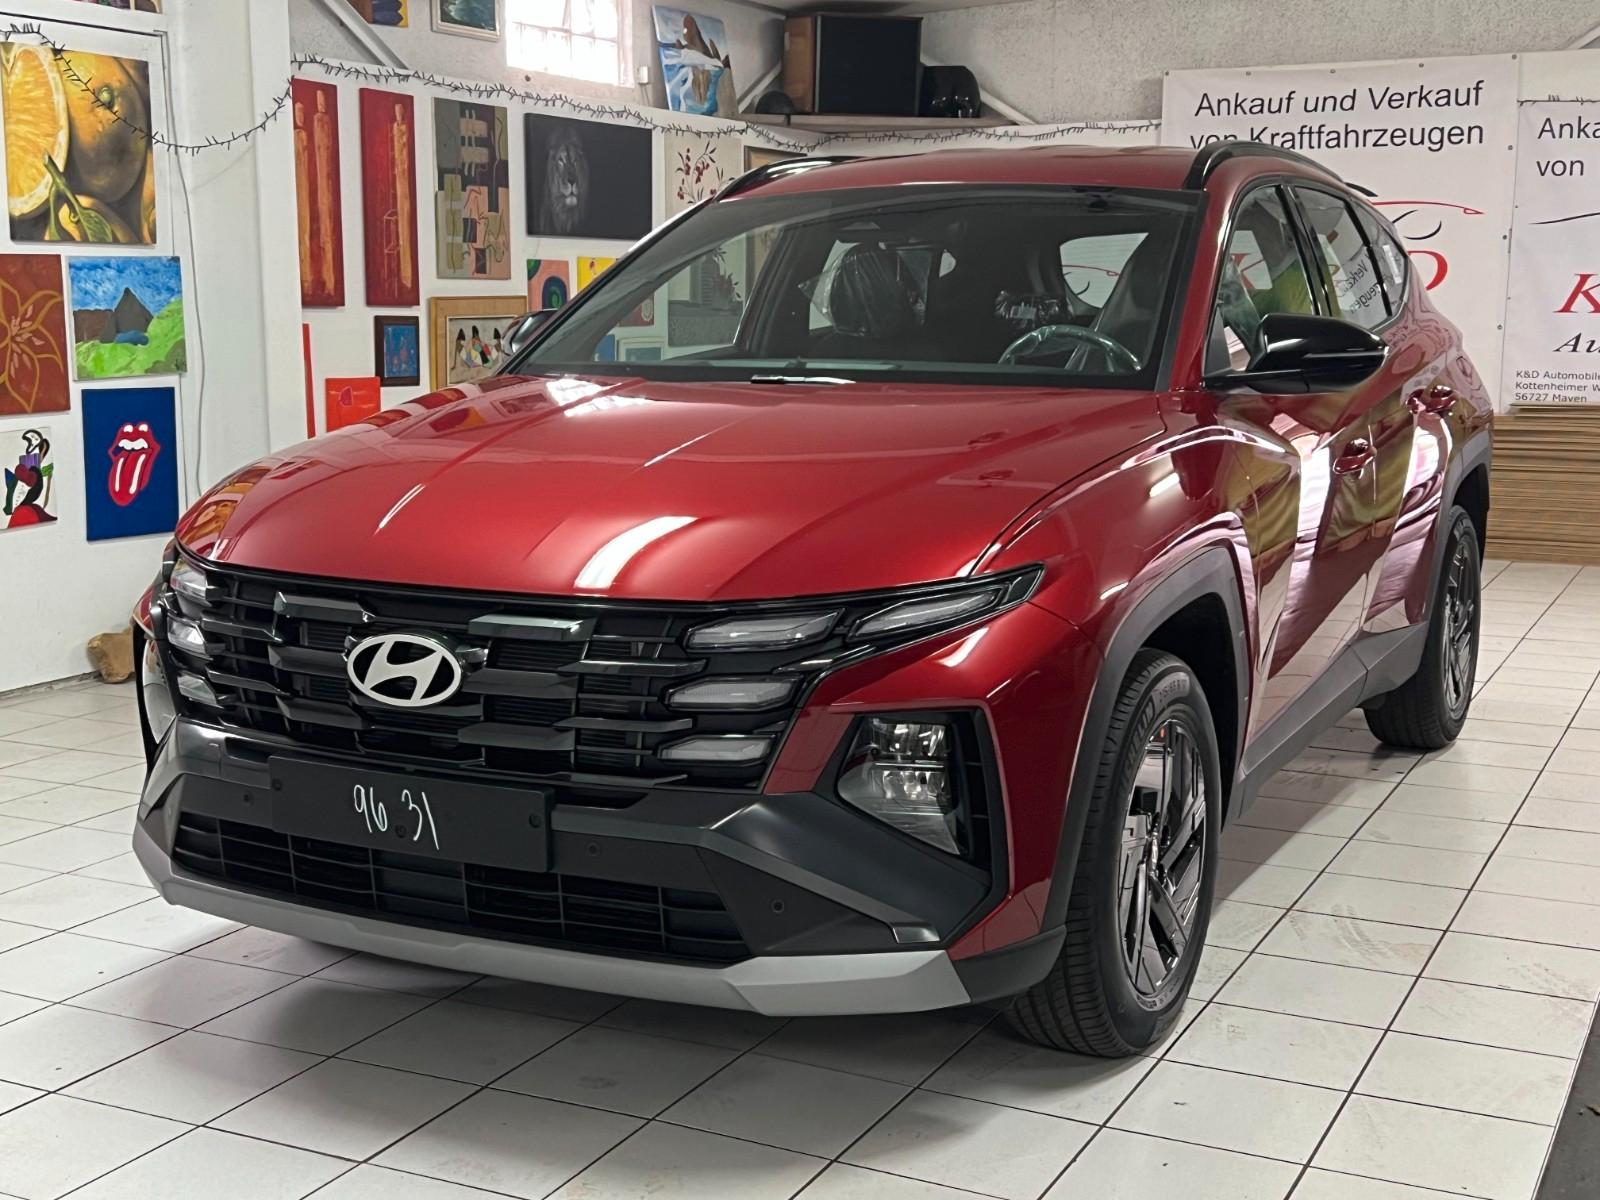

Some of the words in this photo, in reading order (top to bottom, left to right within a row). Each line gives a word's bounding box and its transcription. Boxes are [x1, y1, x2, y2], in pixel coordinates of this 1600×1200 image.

[1194, 90, 1296, 117] Ankauf
[1303, 88, 1357, 113] und
[1368, 79, 1485, 110] Verkauf
[1536, 159, 1584, 177] von
[1516, 370, 1539, 379] K&D
[1515, 381, 1588, 392] Kottenheimer
[1515, 392, 1549, 402] 56727
[353, 784, 388, 833] 96
[401, 790, 440, 850] 31
